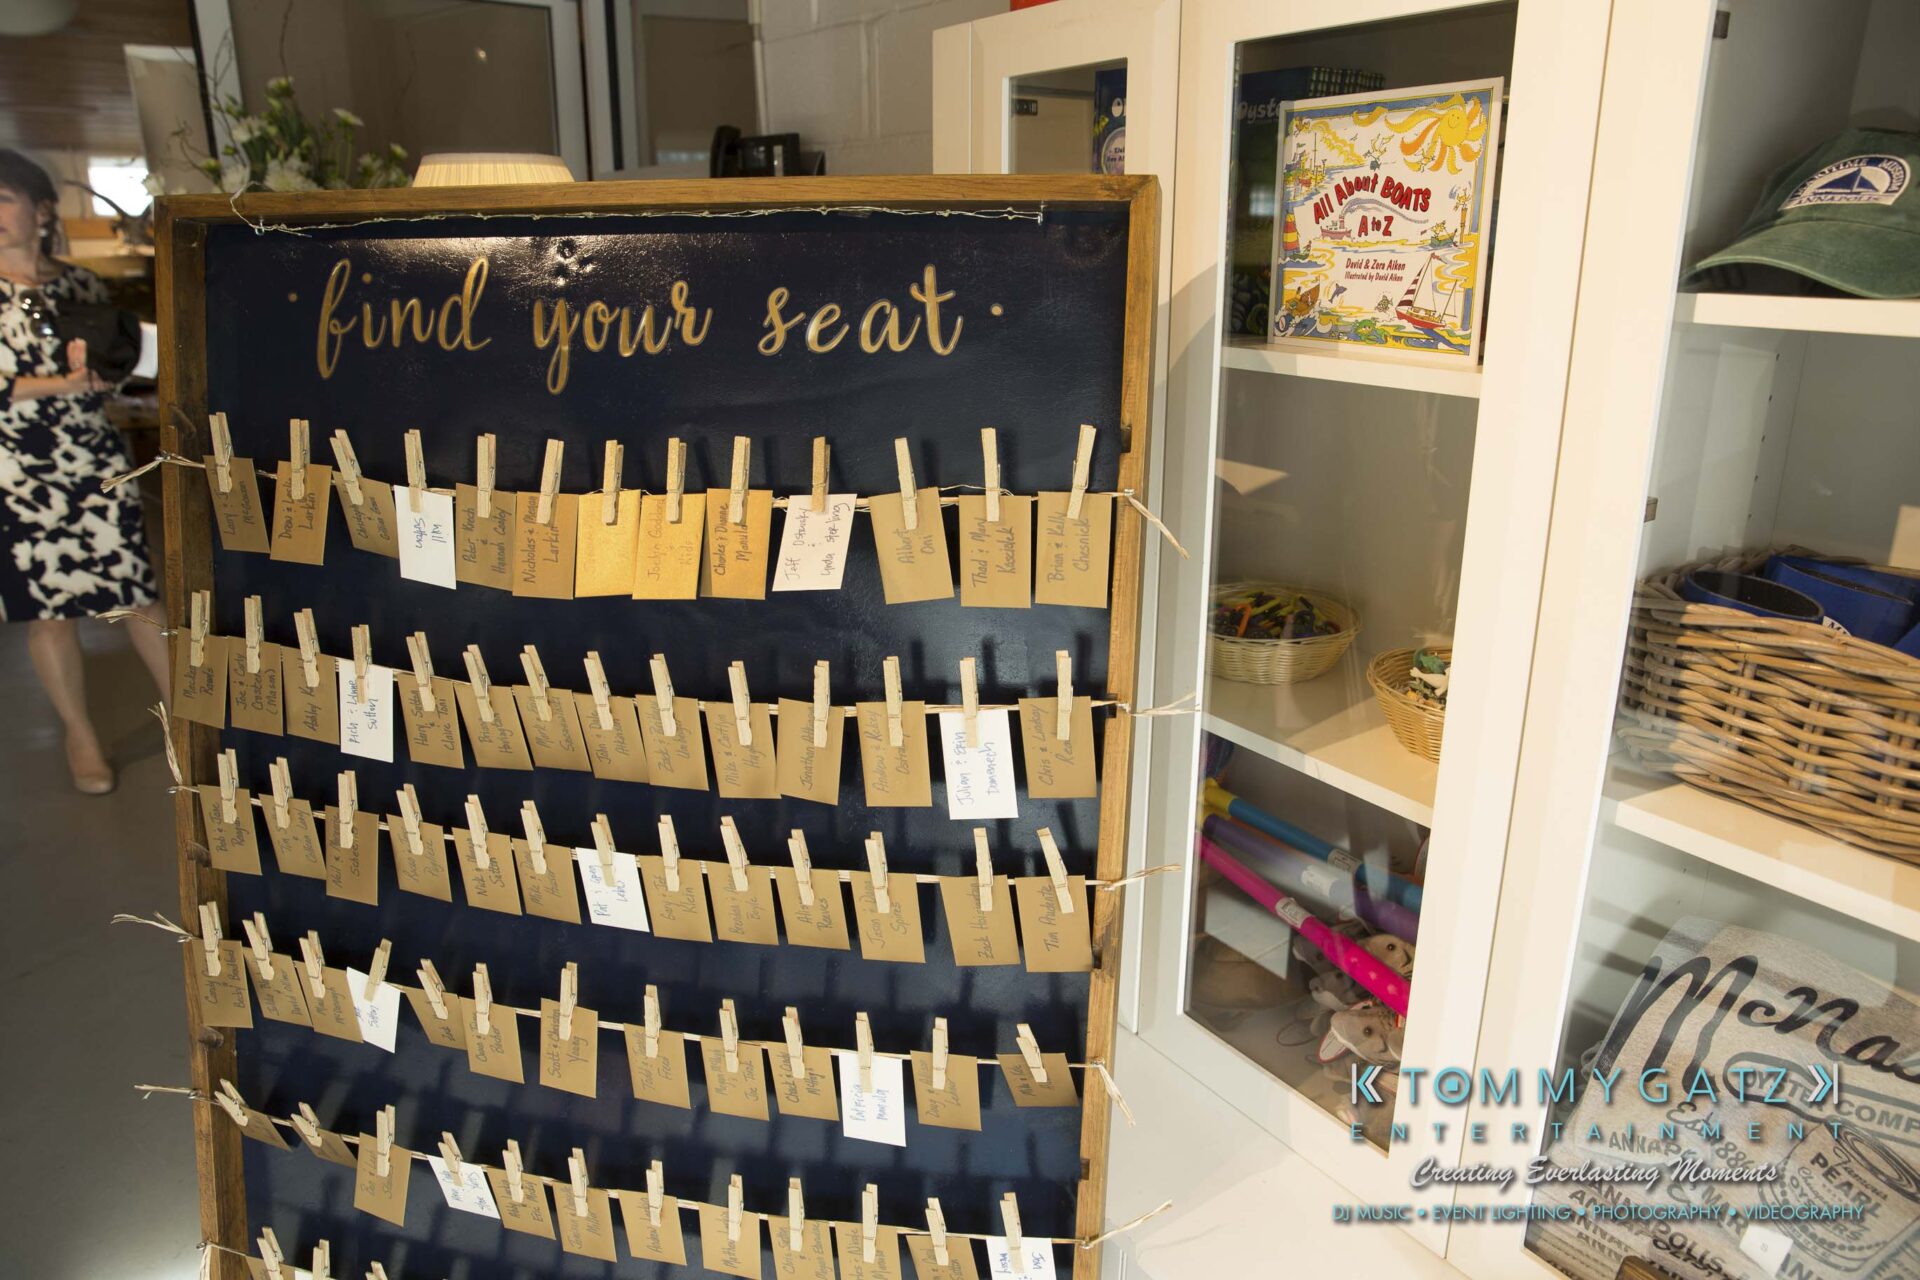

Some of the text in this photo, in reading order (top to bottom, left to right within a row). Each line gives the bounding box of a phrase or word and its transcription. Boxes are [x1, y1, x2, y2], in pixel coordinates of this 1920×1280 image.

[1313, 173, 1432, 225] All About BOATS
[1357, 215, 1393, 237] A to Z
[1344, 272, 1367, 281] Illustrated
[1368, 273, 1374, 282] by
[1375, 273, 1388, 282] David
[1345, 258, 1362, 269] David
[1364, 260, 1370, 269] &
[1387, 260, 1406, 271] Aiken
[317, 257, 963, 394] find your seat
[1047, 512, 1065, 537] Kelly
[523, 538, 537, 583] Nicholas
[714, 544, 727, 575] Charles
[892, 528, 915, 564] Albert
[784, 557, 801, 581] Jeff
[971, 559, 988, 588] Thad
[1047, 553, 1064, 582] Brian
[366, 699, 378, 729] Sutton
[800, 747, 815, 791] Jonathan
[1037, 760, 1054, 785] Chris
[955, 773, 974, 805] Julian
[547, 1052, 561, 1078] Scott
